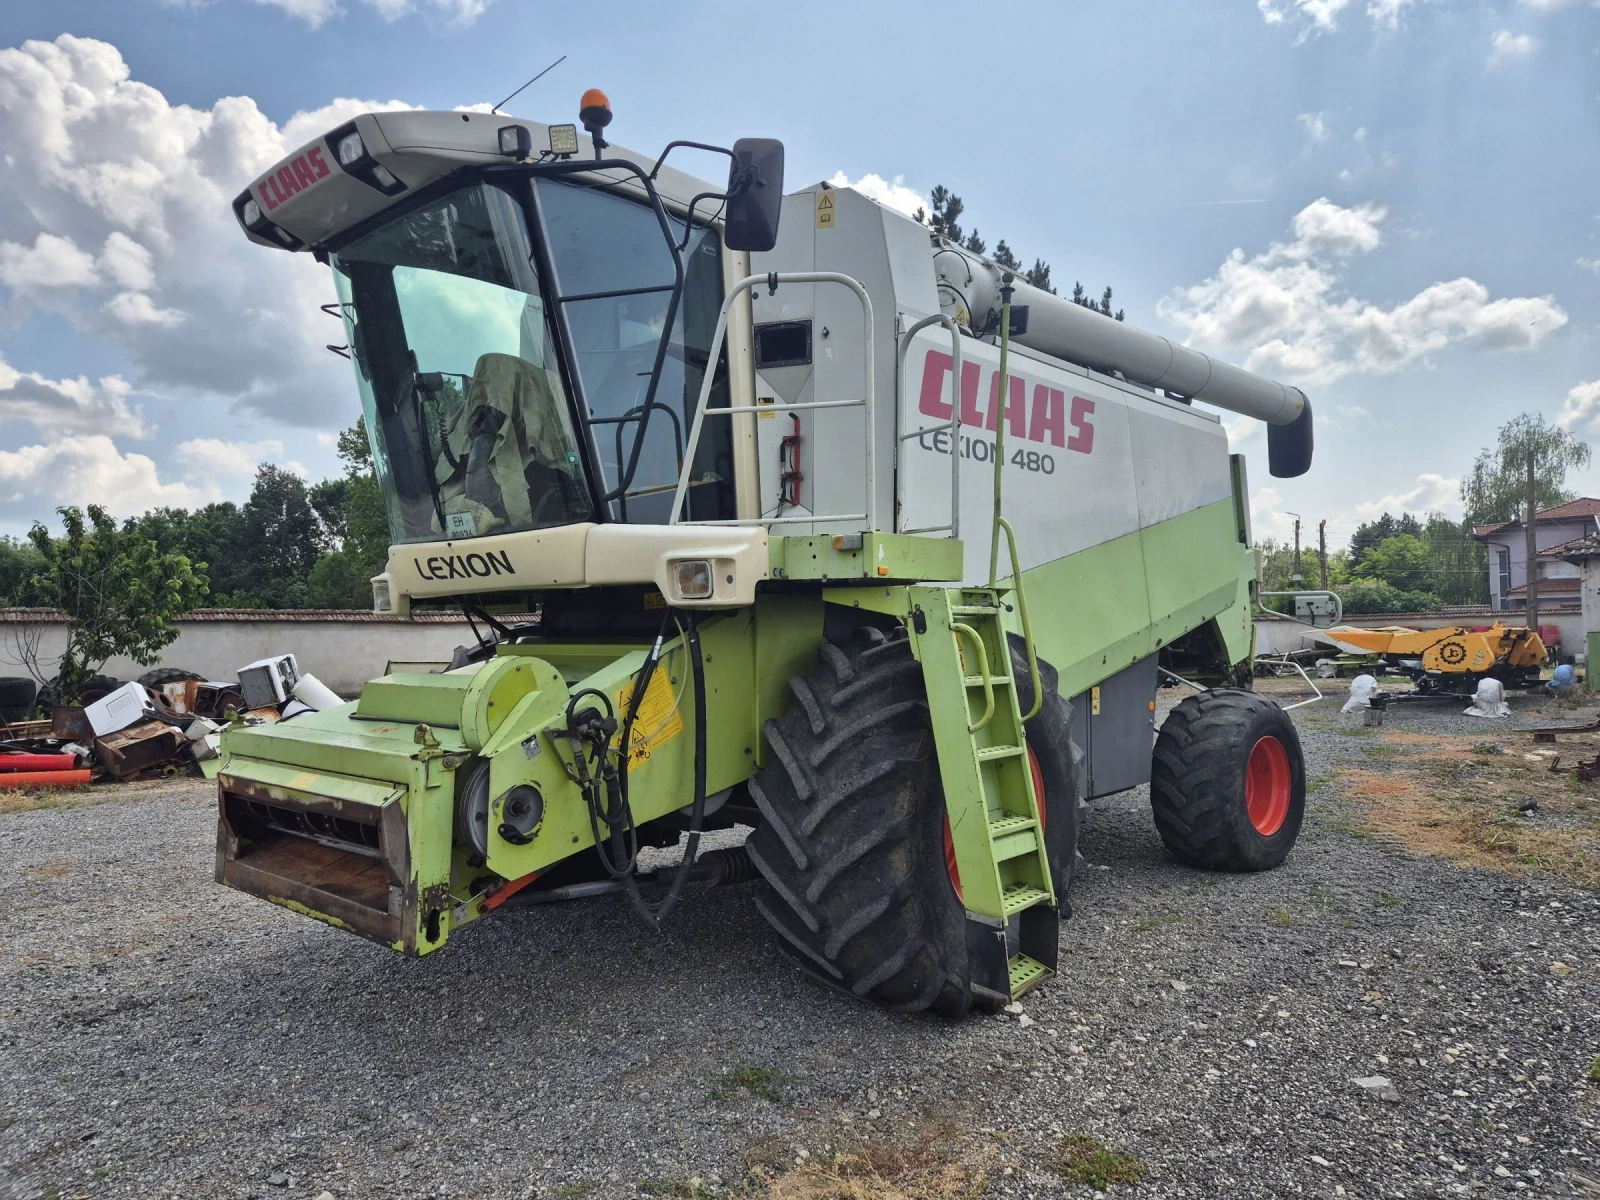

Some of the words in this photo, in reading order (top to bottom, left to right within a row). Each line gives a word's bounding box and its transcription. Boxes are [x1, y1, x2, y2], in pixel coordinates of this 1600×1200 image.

[257, 145, 331, 211] CLAAS
[918, 349, 1096, 455] CLAAS
[1010, 448, 1055, 475] 480
[452, 515, 464, 528] EH
[413, 550, 516, 581] LEXION
